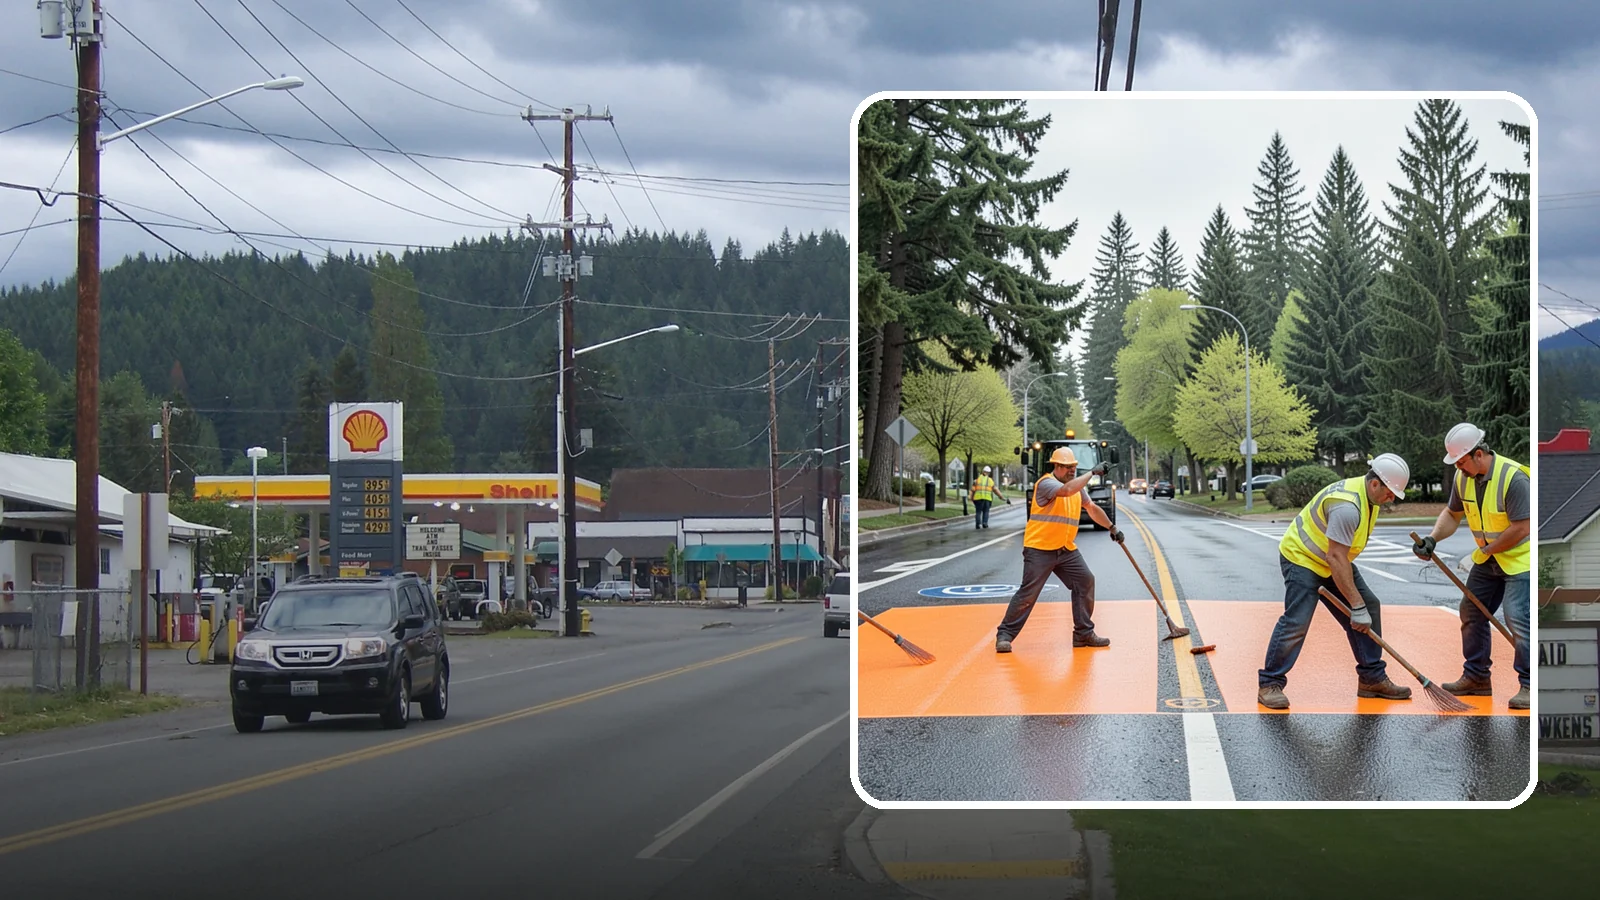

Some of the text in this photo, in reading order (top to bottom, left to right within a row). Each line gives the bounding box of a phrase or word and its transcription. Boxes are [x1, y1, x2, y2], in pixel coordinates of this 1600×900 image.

[365, 480, 384, 490] 395
[490, 484, 547, 498] Shell
[365, 494, 384, 504] 405
[365, 508, 384, 518] 415
[365, 522, 384, 532] 429
[1539, 643, 1566, 665] AID
